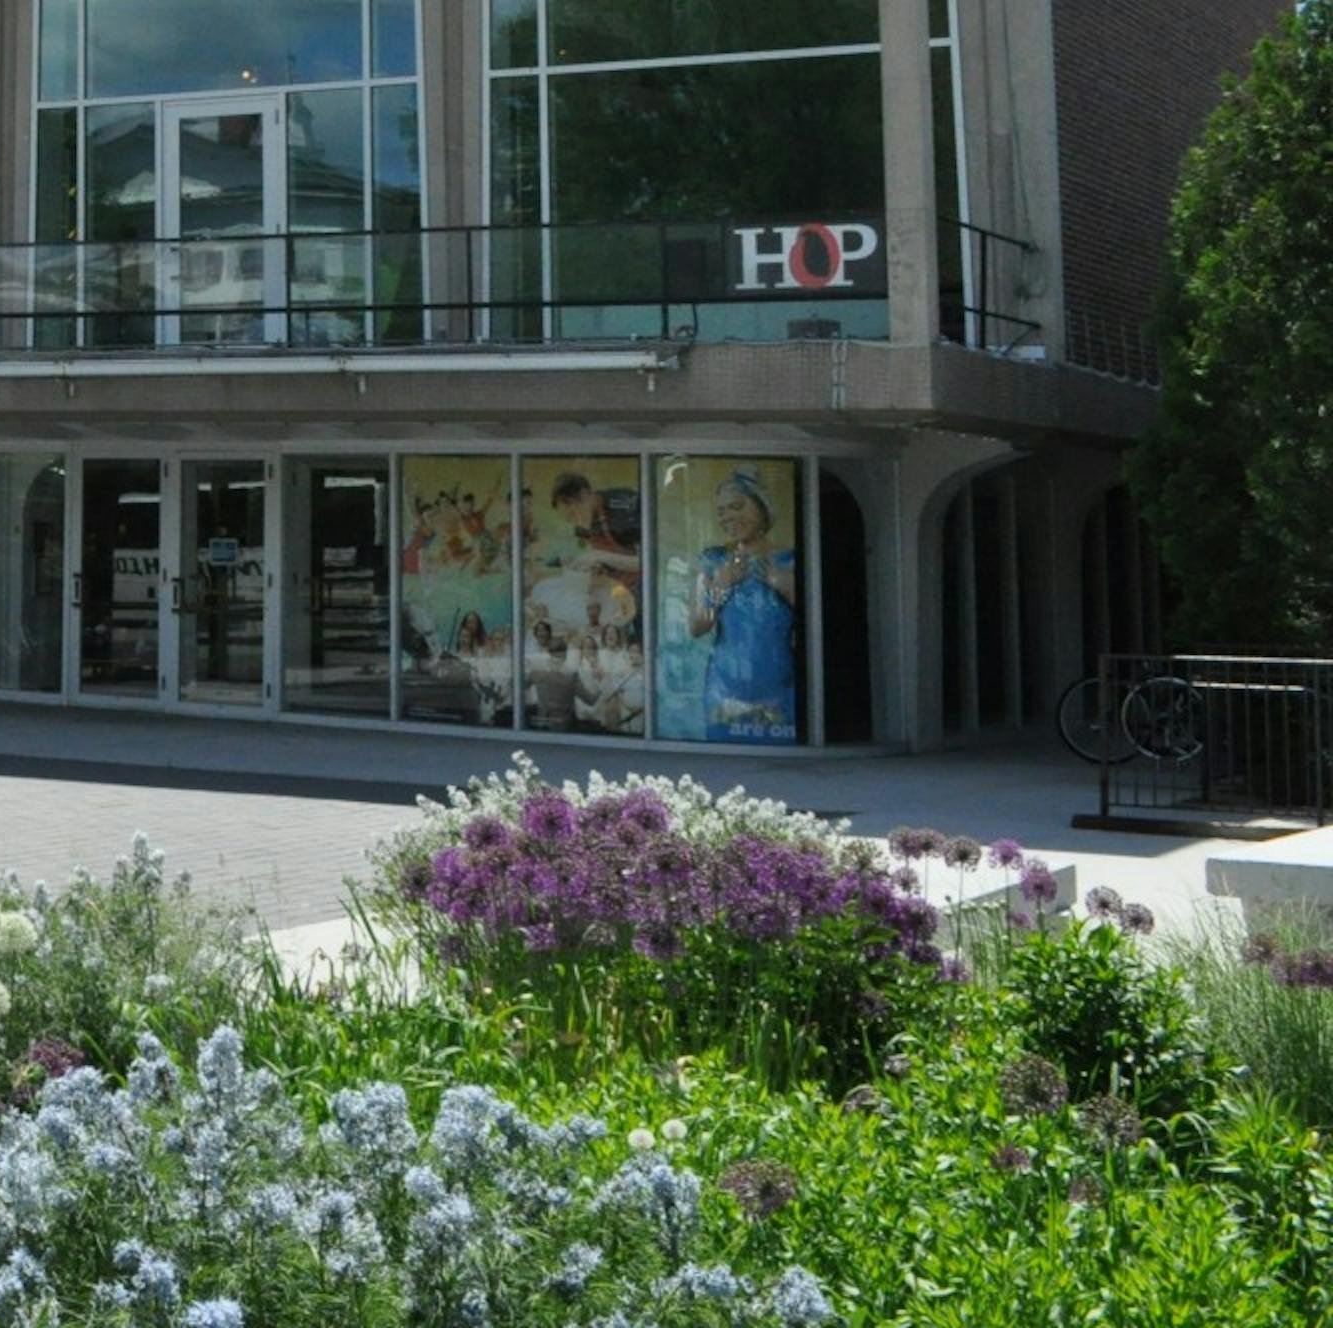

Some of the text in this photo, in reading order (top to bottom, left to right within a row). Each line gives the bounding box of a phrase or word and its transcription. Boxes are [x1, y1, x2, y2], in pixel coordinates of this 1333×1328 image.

[733, 222, 878, 290] HOP
[728, 722, 797, 738] are on
